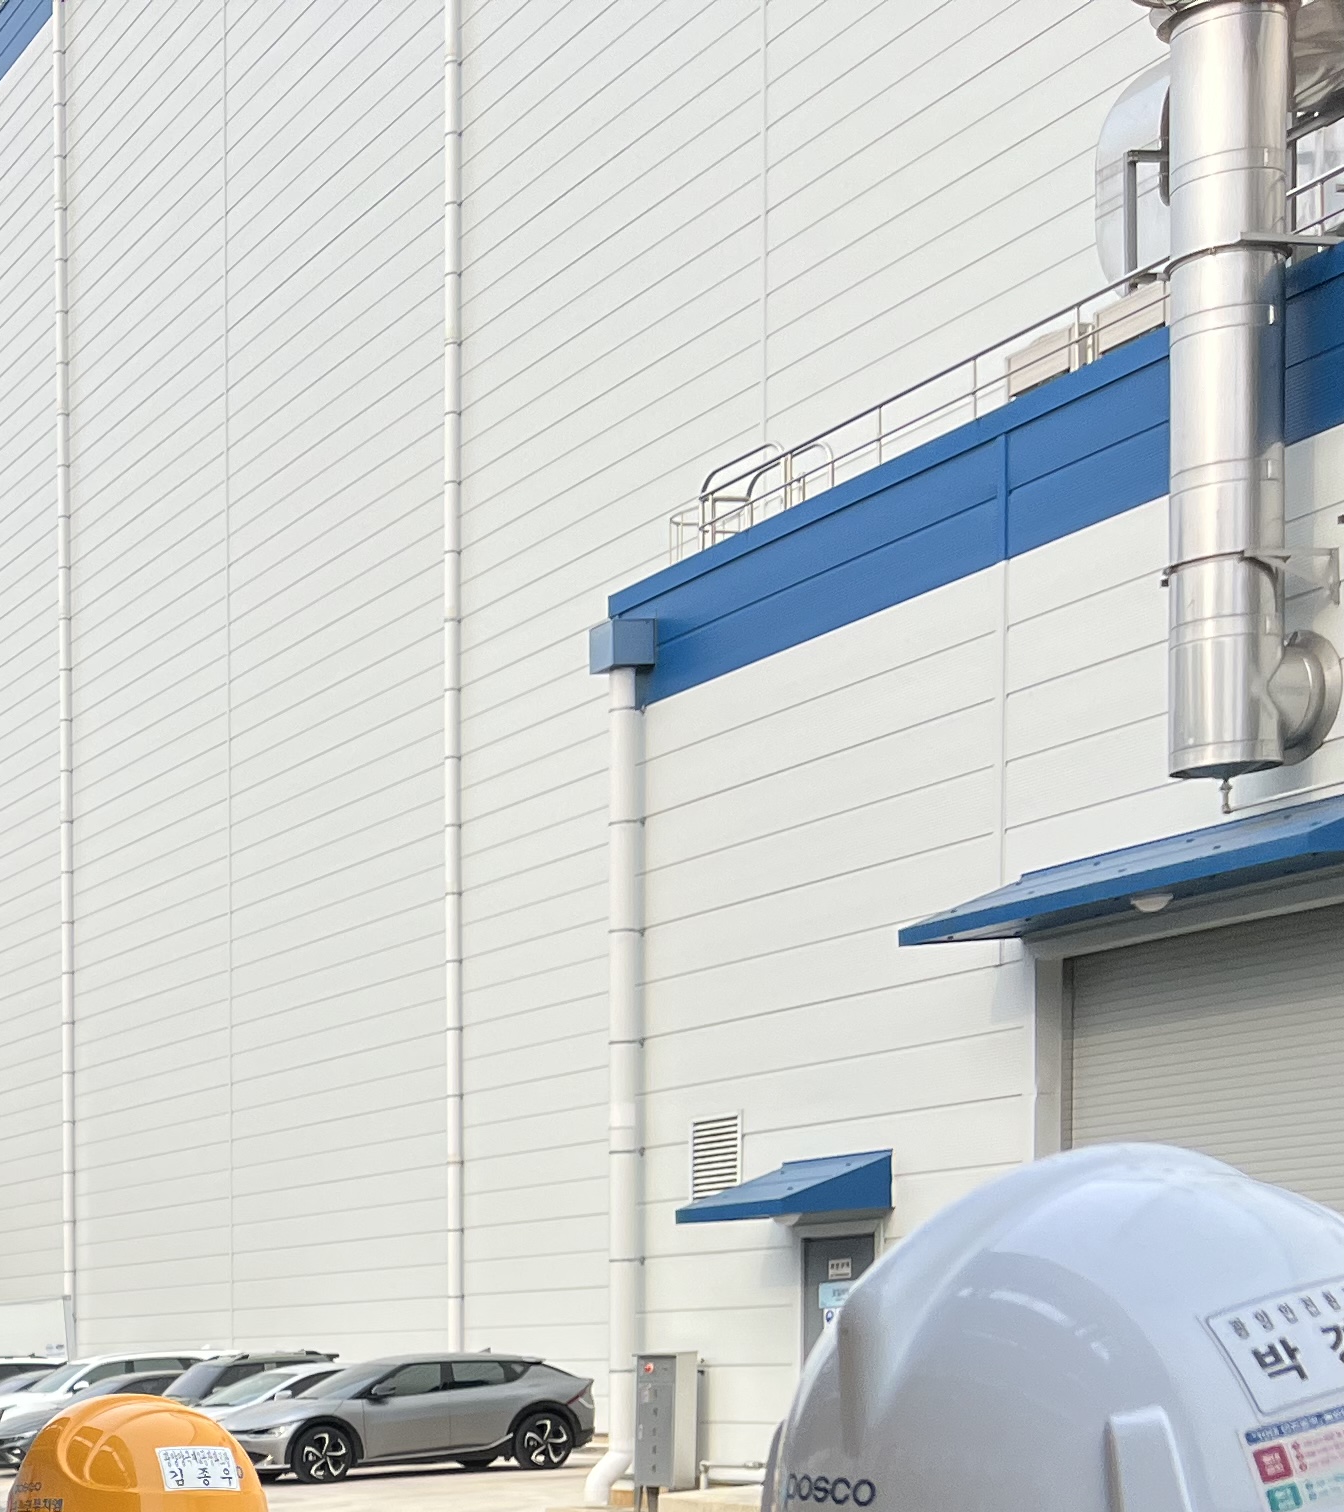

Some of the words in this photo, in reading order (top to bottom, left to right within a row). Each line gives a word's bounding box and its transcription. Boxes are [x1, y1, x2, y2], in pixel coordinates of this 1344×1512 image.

[1252, 1336, 1309, 1381] 박
[169, 1467, 185, 1488] 김
[197, 1467, 213, 1487] 종
[220, 1468, 234, 1487] 우
